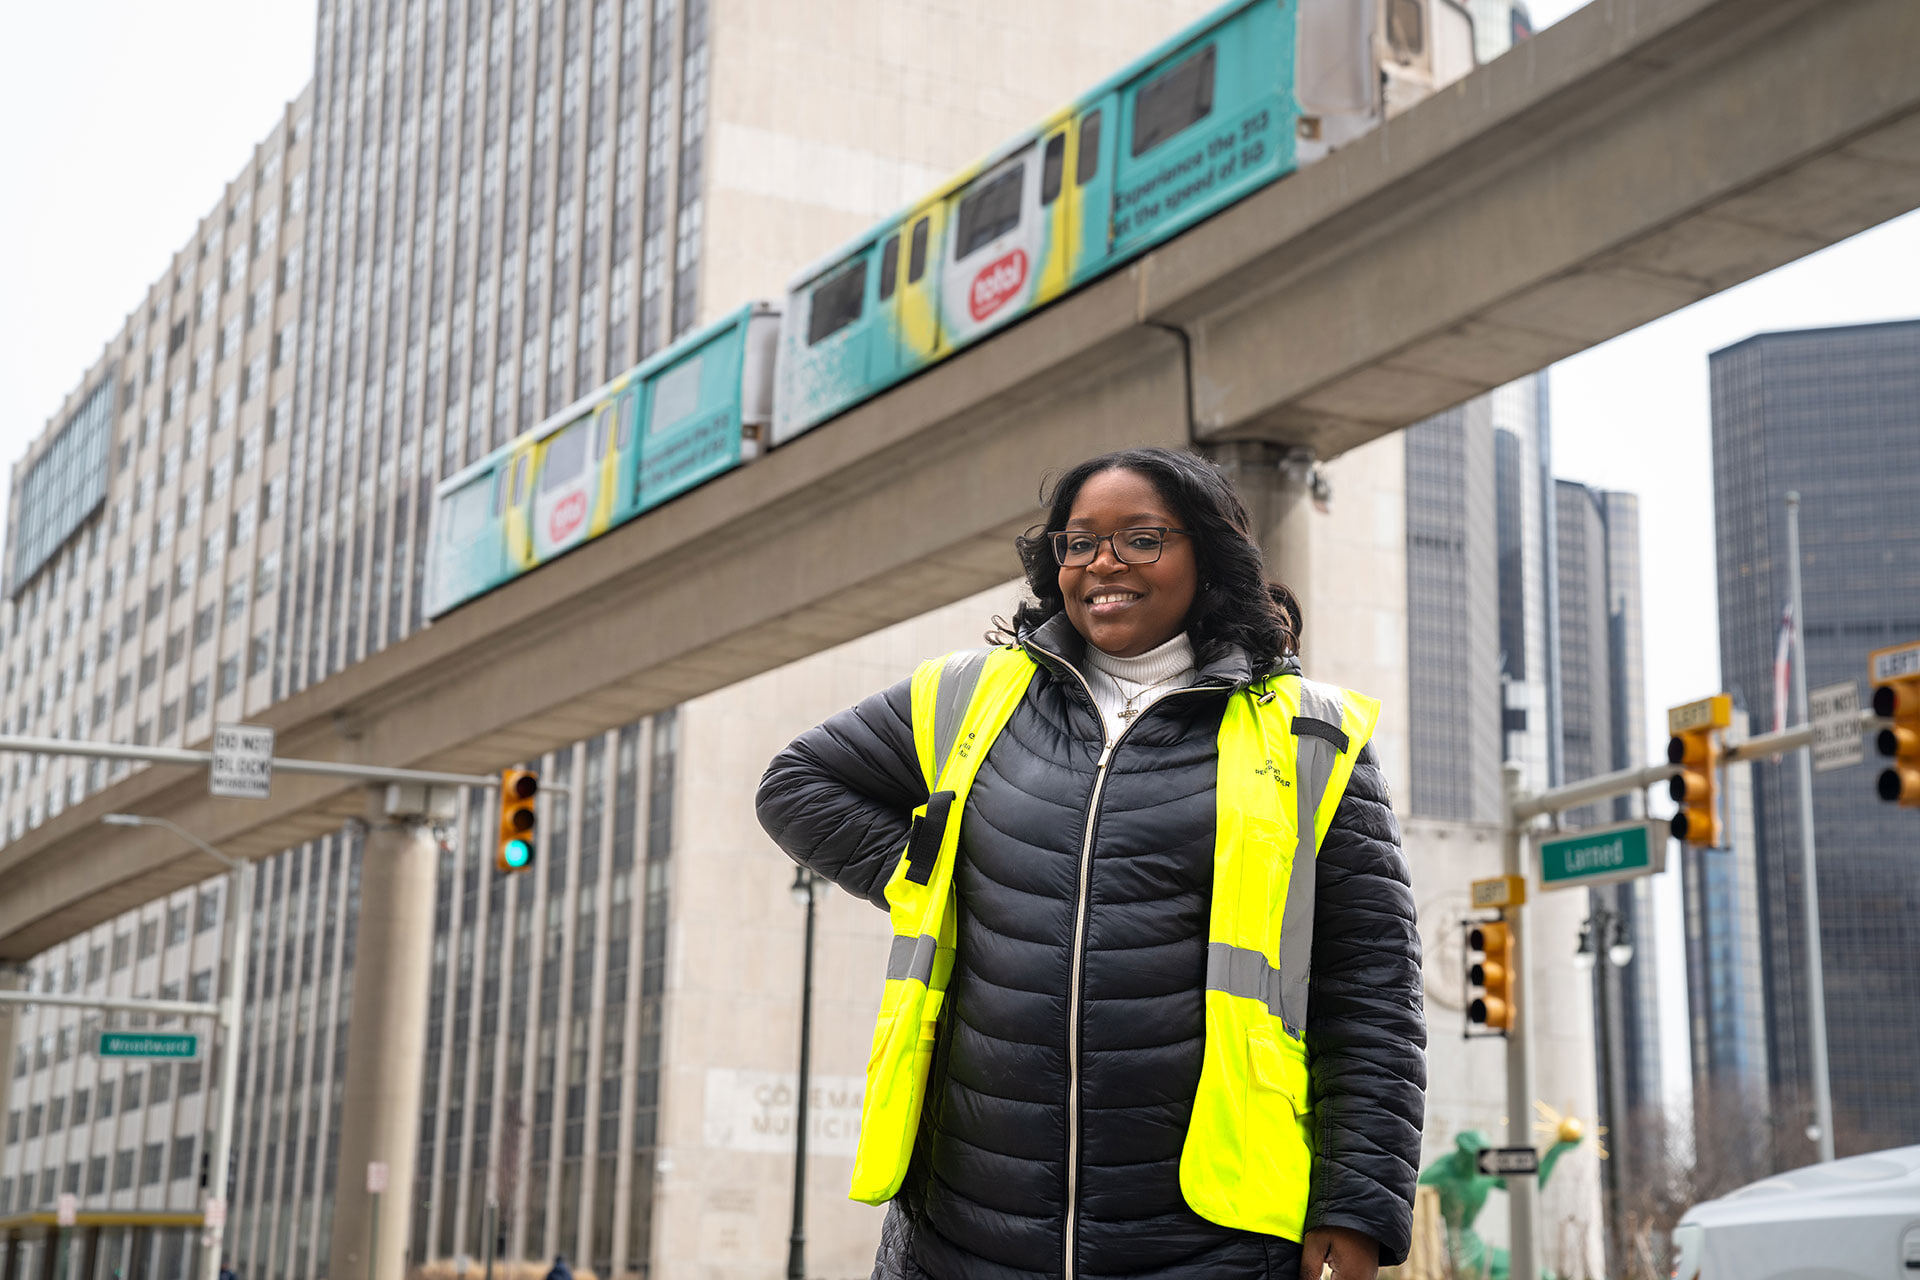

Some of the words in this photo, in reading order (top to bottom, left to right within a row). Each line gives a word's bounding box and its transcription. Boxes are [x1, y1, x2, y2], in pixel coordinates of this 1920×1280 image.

[1114, 153, 1202, 212] Experience
[1208, 133, 1236, 157] the
[1135, 203, 1160, 225] the
[1219, 155, 1236, 180] of
[1564, 838, 1624, 873] Larned
